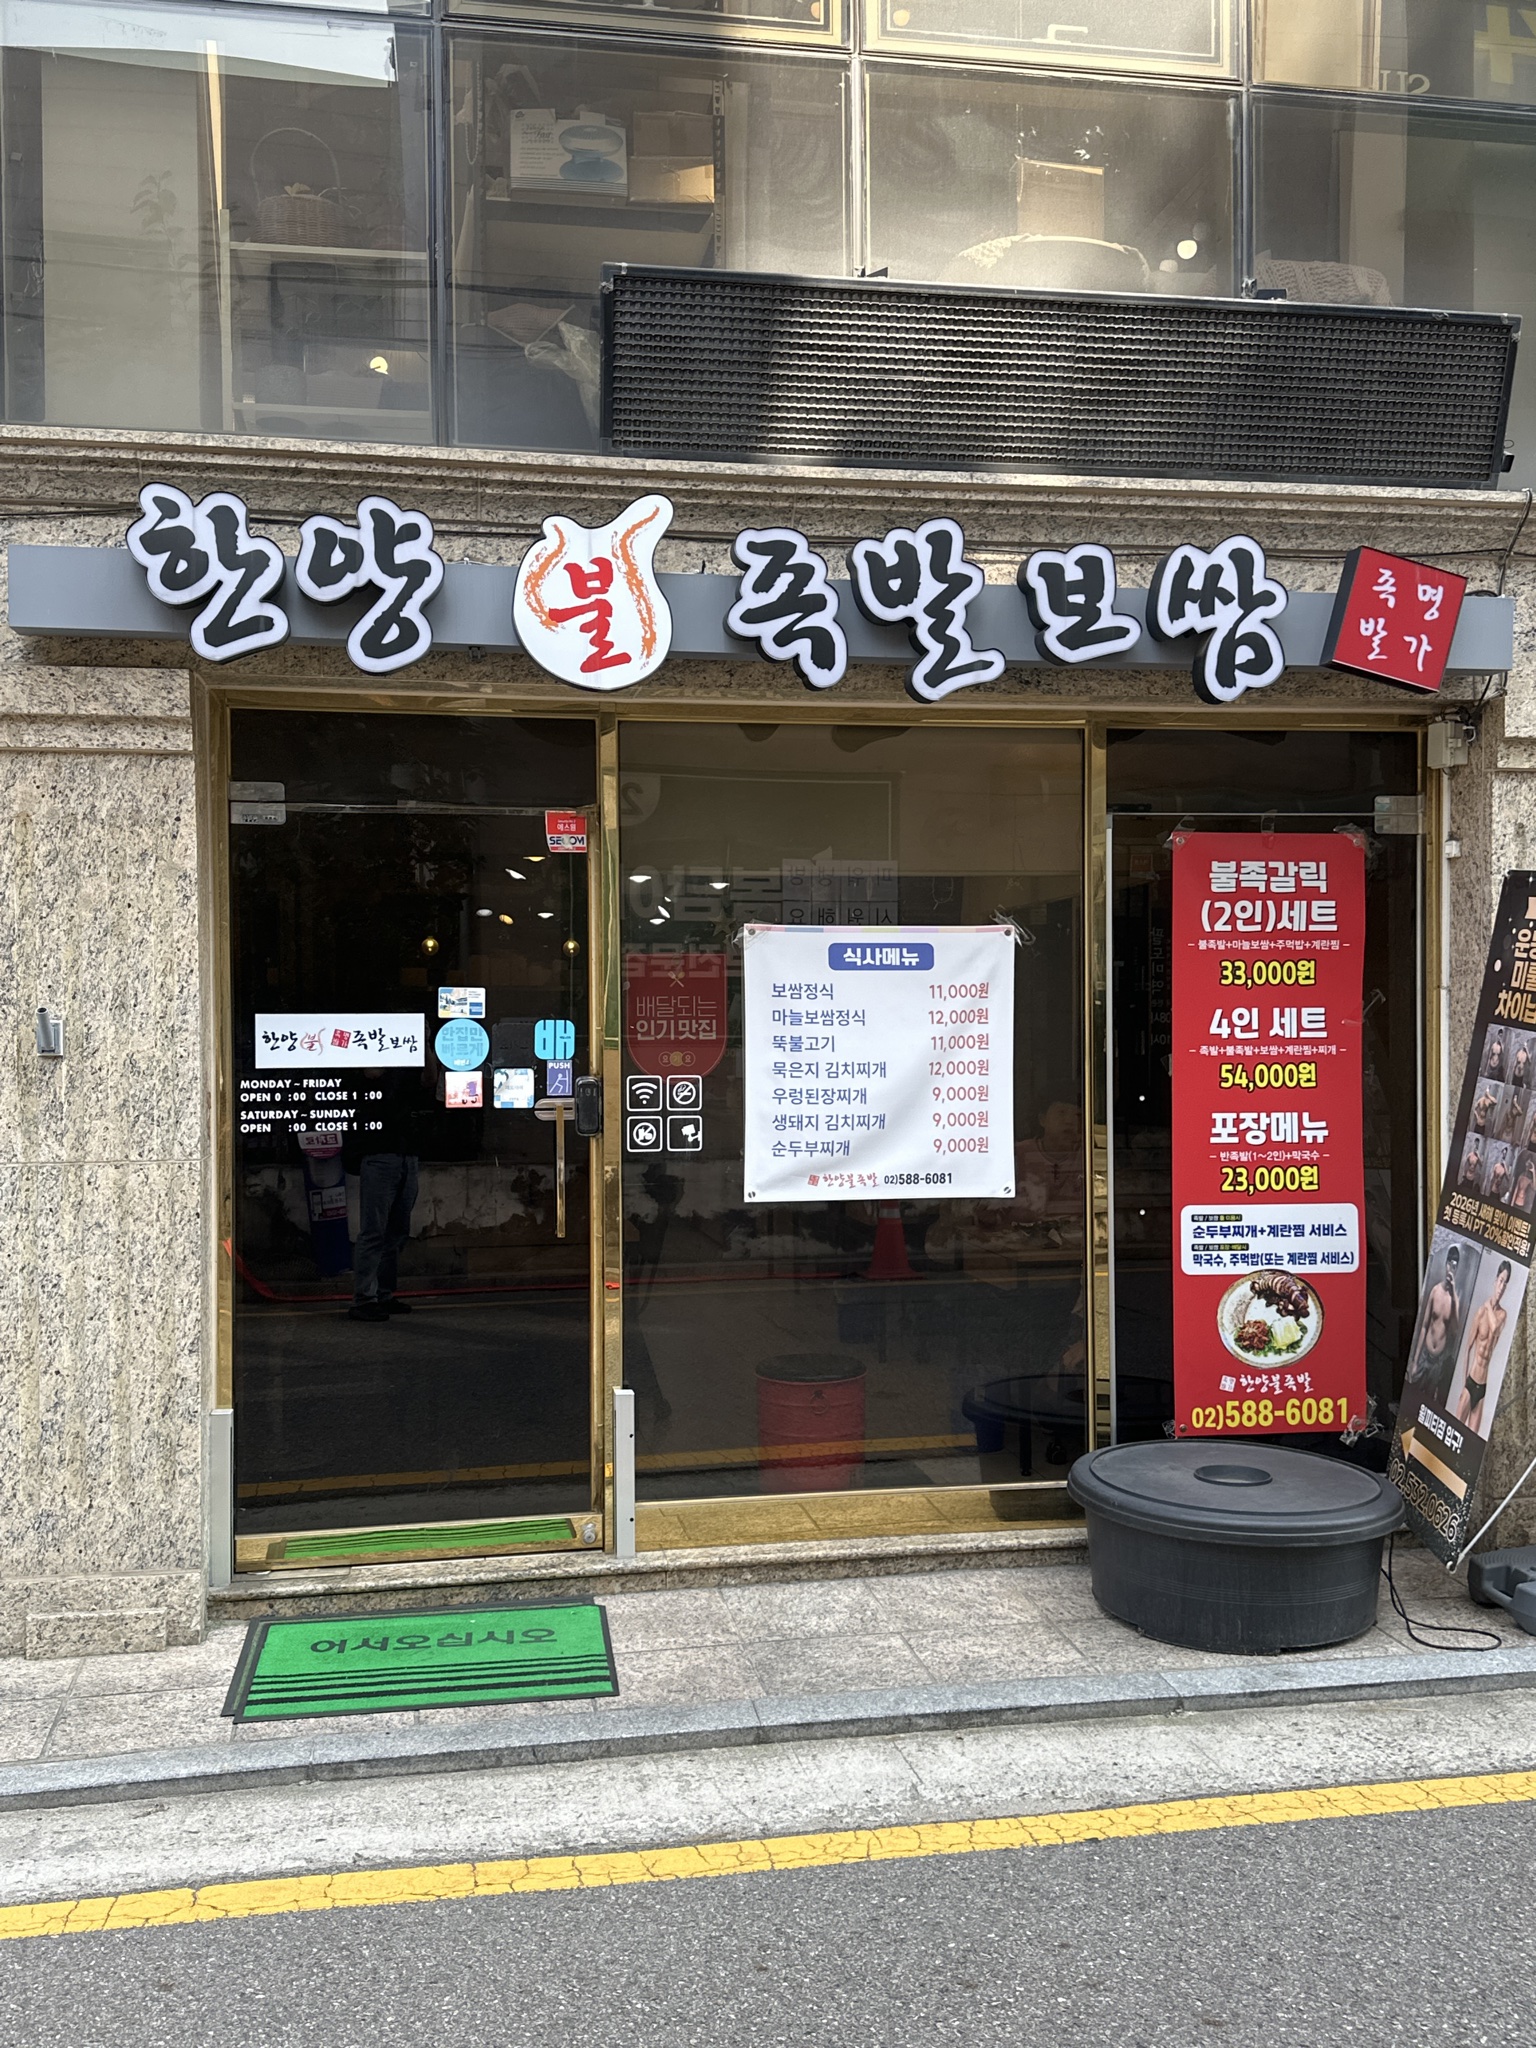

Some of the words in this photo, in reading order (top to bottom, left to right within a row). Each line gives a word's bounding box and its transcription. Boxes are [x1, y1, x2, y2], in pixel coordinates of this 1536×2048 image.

[138, 496, 430, 657] 한양
[549, 557, 633, 674] 불
[1209, 861, 1327, 893] 불족갈릭
[1201, 900, 1338, 932] (2인)세트
[843, 948, 920, 966] 식사메뉴
[1220, 960, 1316, 989] 33,000원
[772, 983, 834, 1000] 보쌈정식
[929, 982, 989, 1001] 11,000원
[636, 996, 717, 1018] 배달되는
[772, 1009, 866, 1026] 마늘보쌈정식
[928, 1008, 989, 1027] 12,000원
[1209, 1007, 1259, 1039] 4인
[1269, 1007, 1328, 1038] 세트
[262, 1031, 299, 1051] 한양
[441, 1026, 484, 1041] 한집만
[772, 1035, 836, 1052] 뚝불고기
[930, 1034, 989, 1052] 11,000원
[441, 1043, 484, 1057] 빠르게
[772, 1061, 819, 1079] 묵은지
[825, 1061, 887, 1078] 김치찌개
[929, 1059, 989, 1078] 12,000원
[1220, 1062, 1317, 1092] 54,000원
[240, 1080, 291, 1089] MONDAY
[303, 1079, 342, 1088] FRIDAY
[240, 1093, 271, 1102] OPEN
[315, 1091, 348, 1101] CLOSE
[772, 1088, 867, 1105] 우렁된장찌개
[932, 1085, 989, 1104] 9,000원
[240, 1110, 298, 1120] SATURDAY
[310, 1109, 356, 1119] SUNDAY
[772, 1114, 819, 1132] 생돼지
[825, 1113, 886, 1131] 김치찌개
[932, 1111, 989, 1130] 9,000원
[240, 1124, 271, 1133] OPEN
[315, 1122, 348, 1131] CLOSE
[1210, 1111, 1329, 1145] 포장메뉴
[771, 1140, 851, 1157] 순두부찌개
[933, 1136, 989, 1156] 9,000원
[884, 1173, 952, 1186] 02)588-6081
[1221, 1165, 1319, 1195] 23,000원
[1449, 1191, 1479, 1216] 2026년
[1193, 1224, 1305, 1239] 순두부찌개+계란찜
[1309, 1224, 1347, 1237] 서비스
[1193, 1253, 1227, 1267] 막국수,
[1287, 1252, 1318, 1265] 계란찜
[1320, 1251, 1355, 1265] 서비스)
[1192, 1397, 1348, 1430] 02)588-6081
[1444, 1425, 1464, 1454] 입구!
[311, 1628, 557, 1655] 어서오십시오
